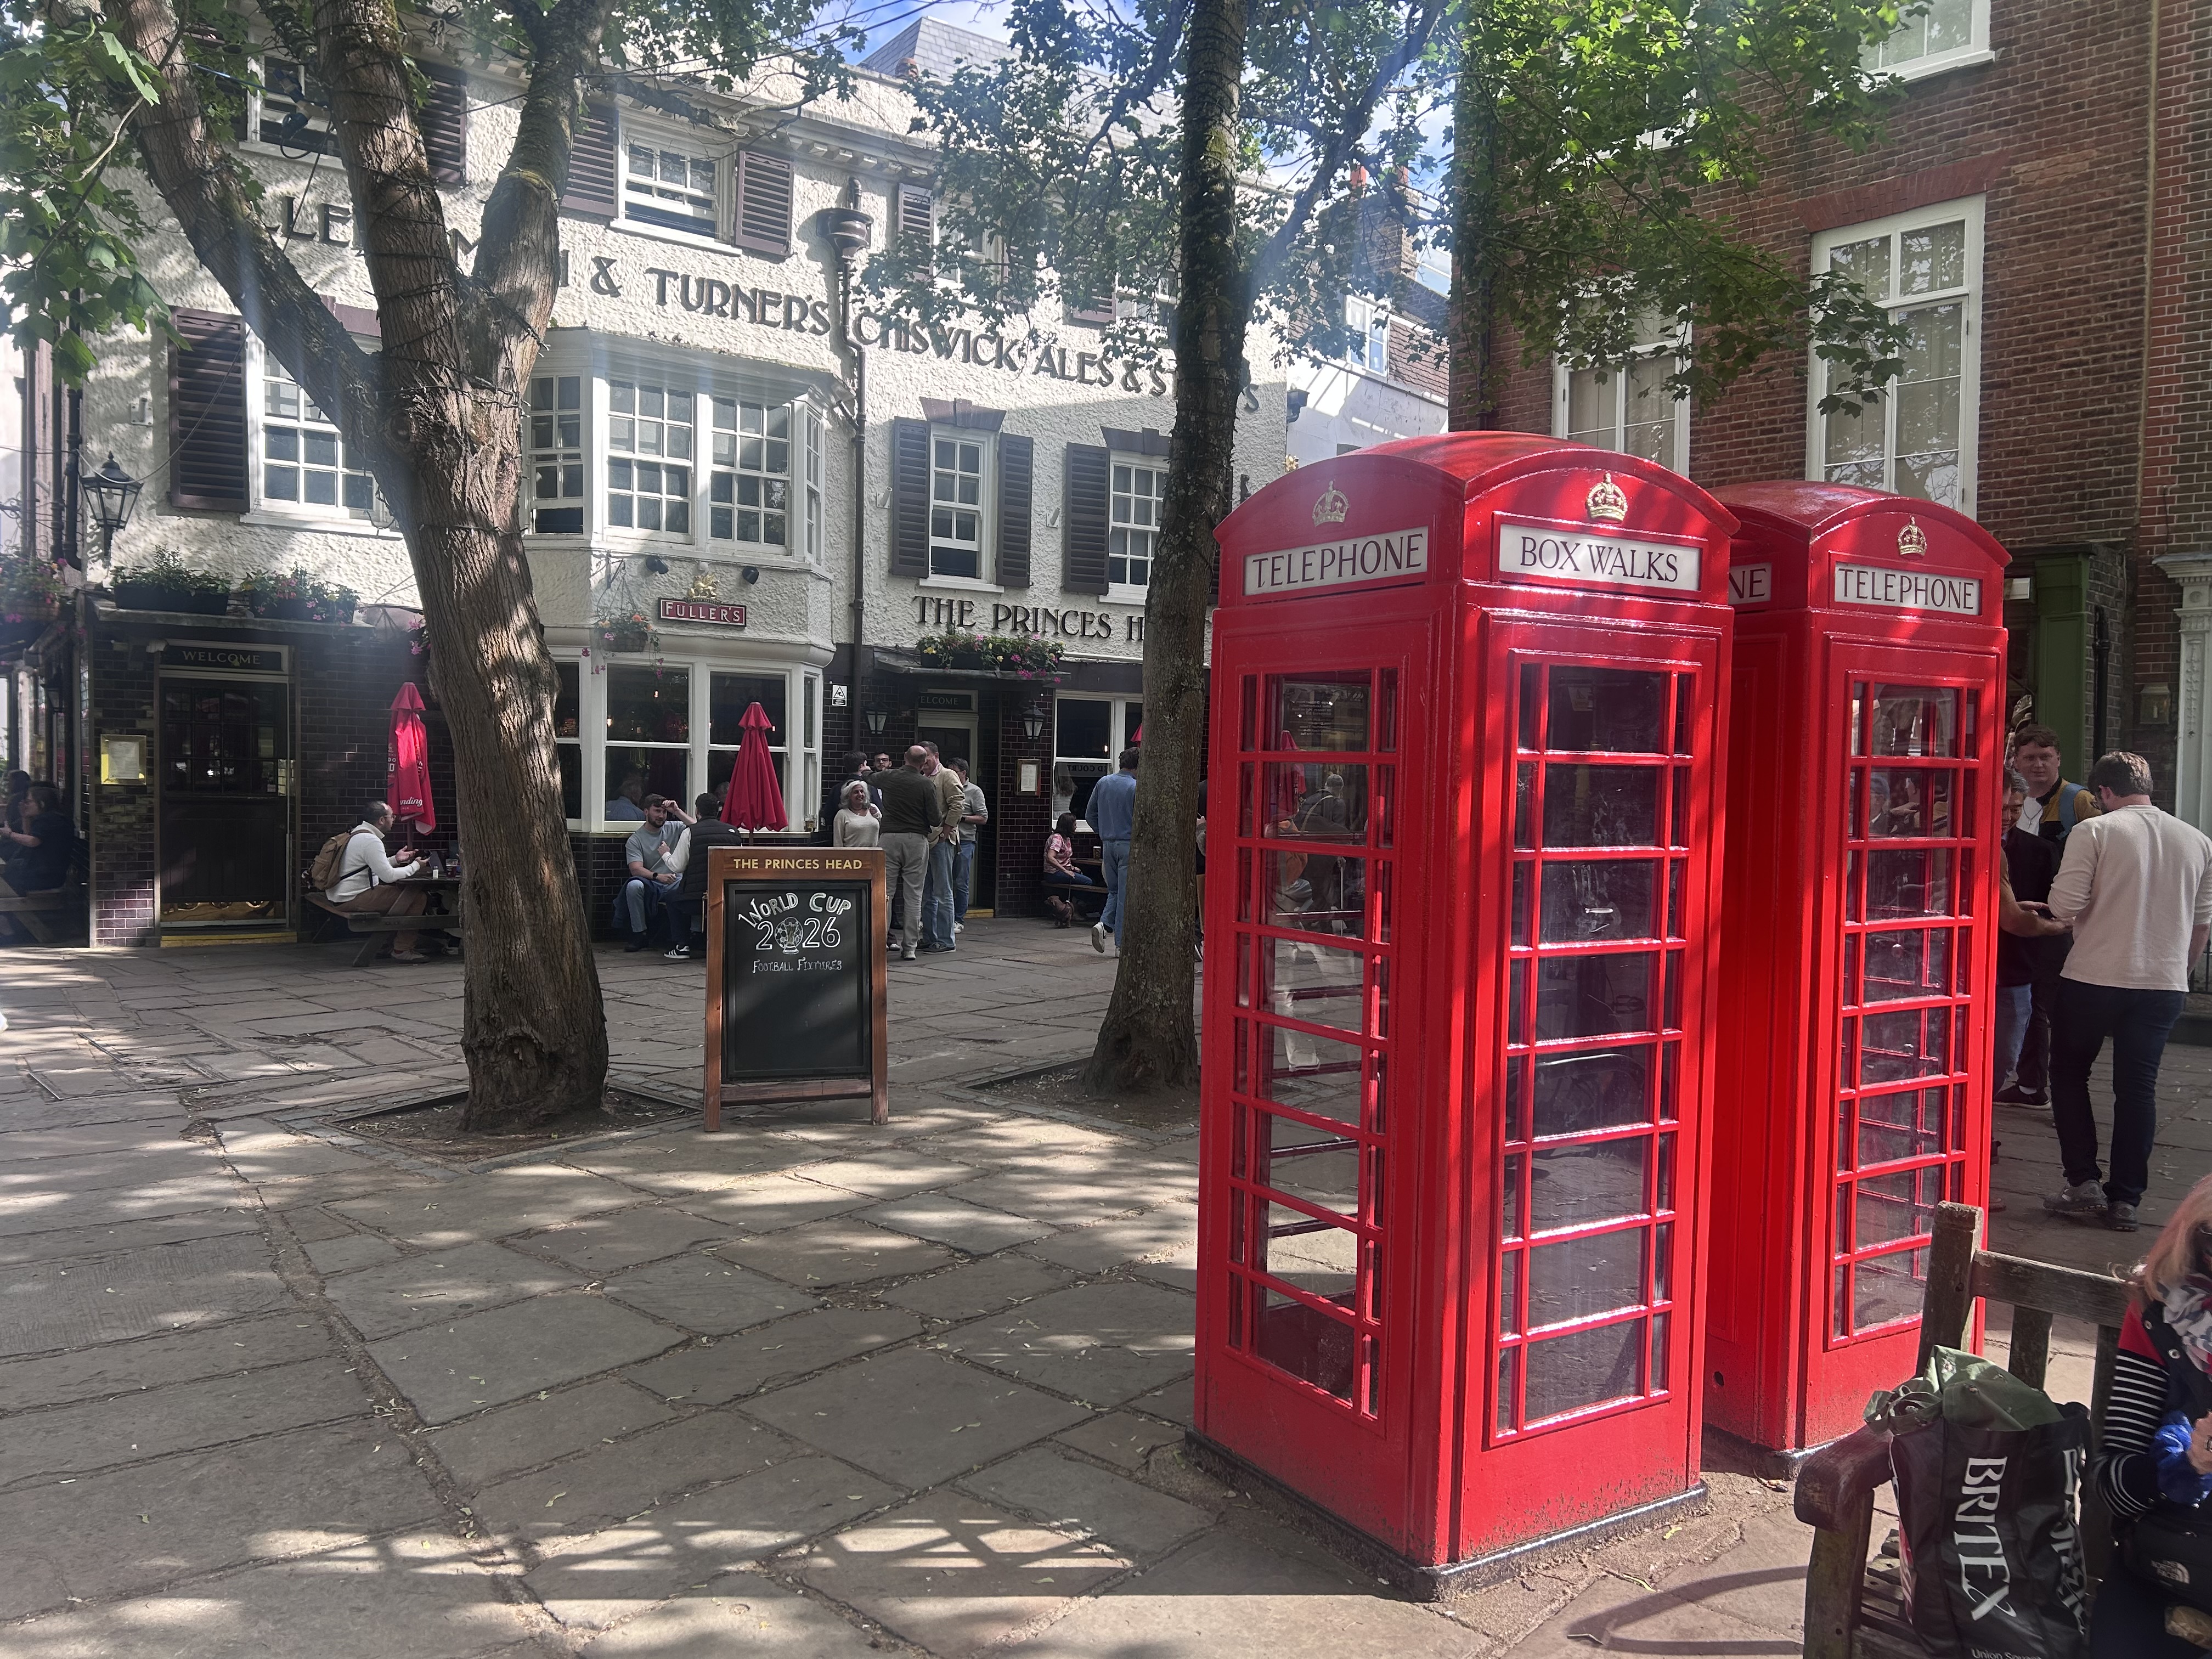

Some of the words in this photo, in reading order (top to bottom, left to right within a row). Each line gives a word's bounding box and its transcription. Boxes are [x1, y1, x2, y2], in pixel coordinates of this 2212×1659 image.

[590, 256, 623, 298] &
[645, 267, 831, 336] TURNER'S
[1032, 345, 1114, 388] ALES
[1251, 533, 1424, 588] TELEPHONE
[1520, 536, 1581, 572] BOX
[1587, 544, 1679, 582] WALKS
[1838, 568, 1974, 610] TELEPHONE
[665, 601, 741, 623] FULLER'S
[913, 595, 977, 627] THE
[991, 603, 1111, 639] PRINCES
[182, 651, 261, 664] WELCOME
[918, 696, 958, 706] ELCOME
[733, 859, 759, 869] THE
[765, 859, 820, 870] PRINCES
[826, 859, 862, 870] HEAD
[738, 892, 799, 928] WORLD
[809, 892, 851, 916] CUP
[752, 959, 794, 973] FOOTBALL
[797, 957, 843, 971] FIXTURES
[1953, 1455, 2017, 1621] BRITEX
[1971, 1647, 2003, 1659] Union
